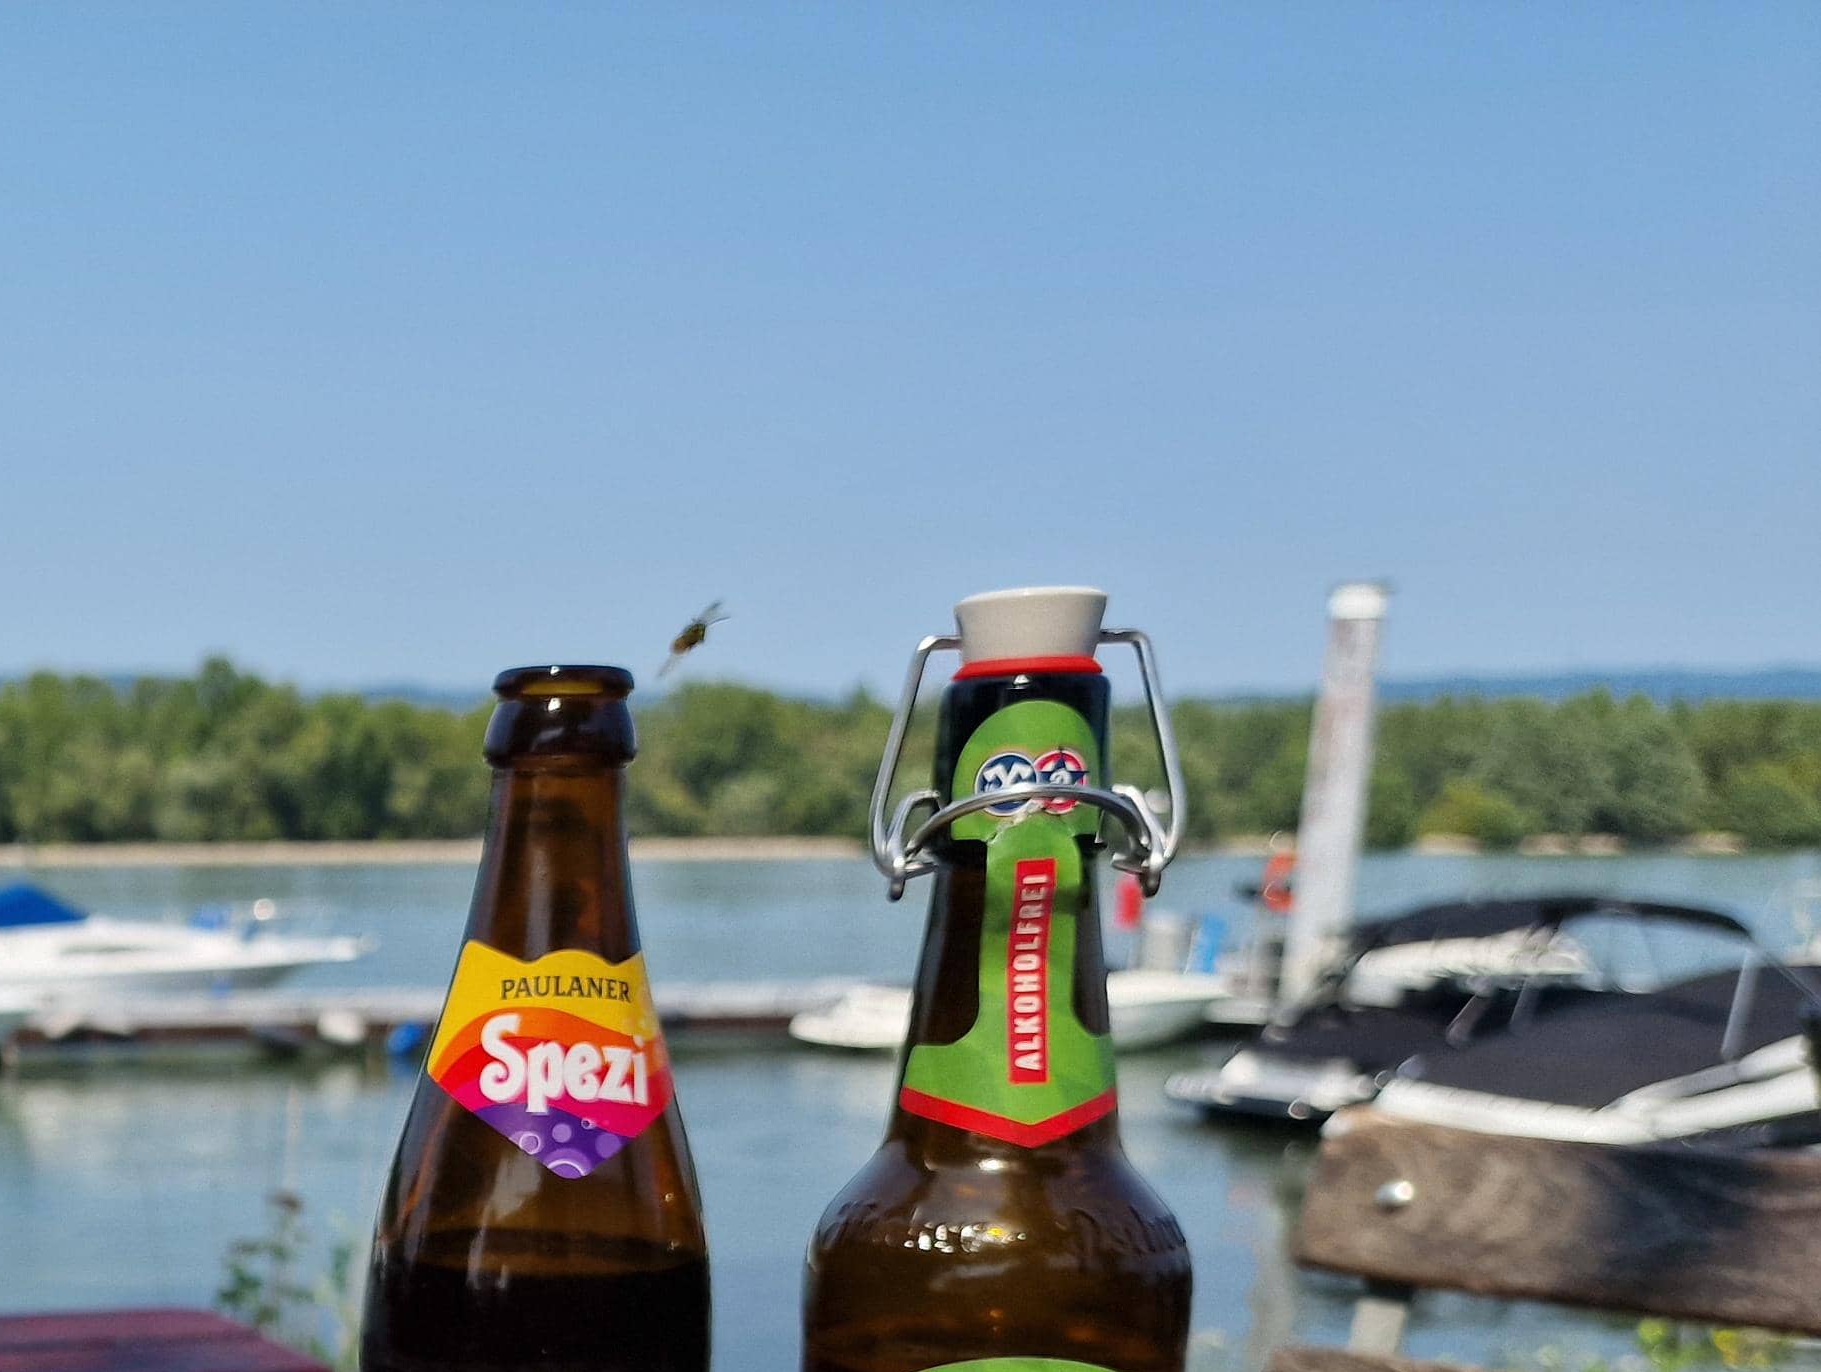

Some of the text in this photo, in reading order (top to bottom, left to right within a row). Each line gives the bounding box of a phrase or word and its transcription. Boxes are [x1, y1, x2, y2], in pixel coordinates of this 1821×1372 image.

[501, 975, 631, 1002] PAULANER
[1014, 873, 1049, 1071] ALKOHOLFREI
[480, 1013, 649, 1114] Spezi
